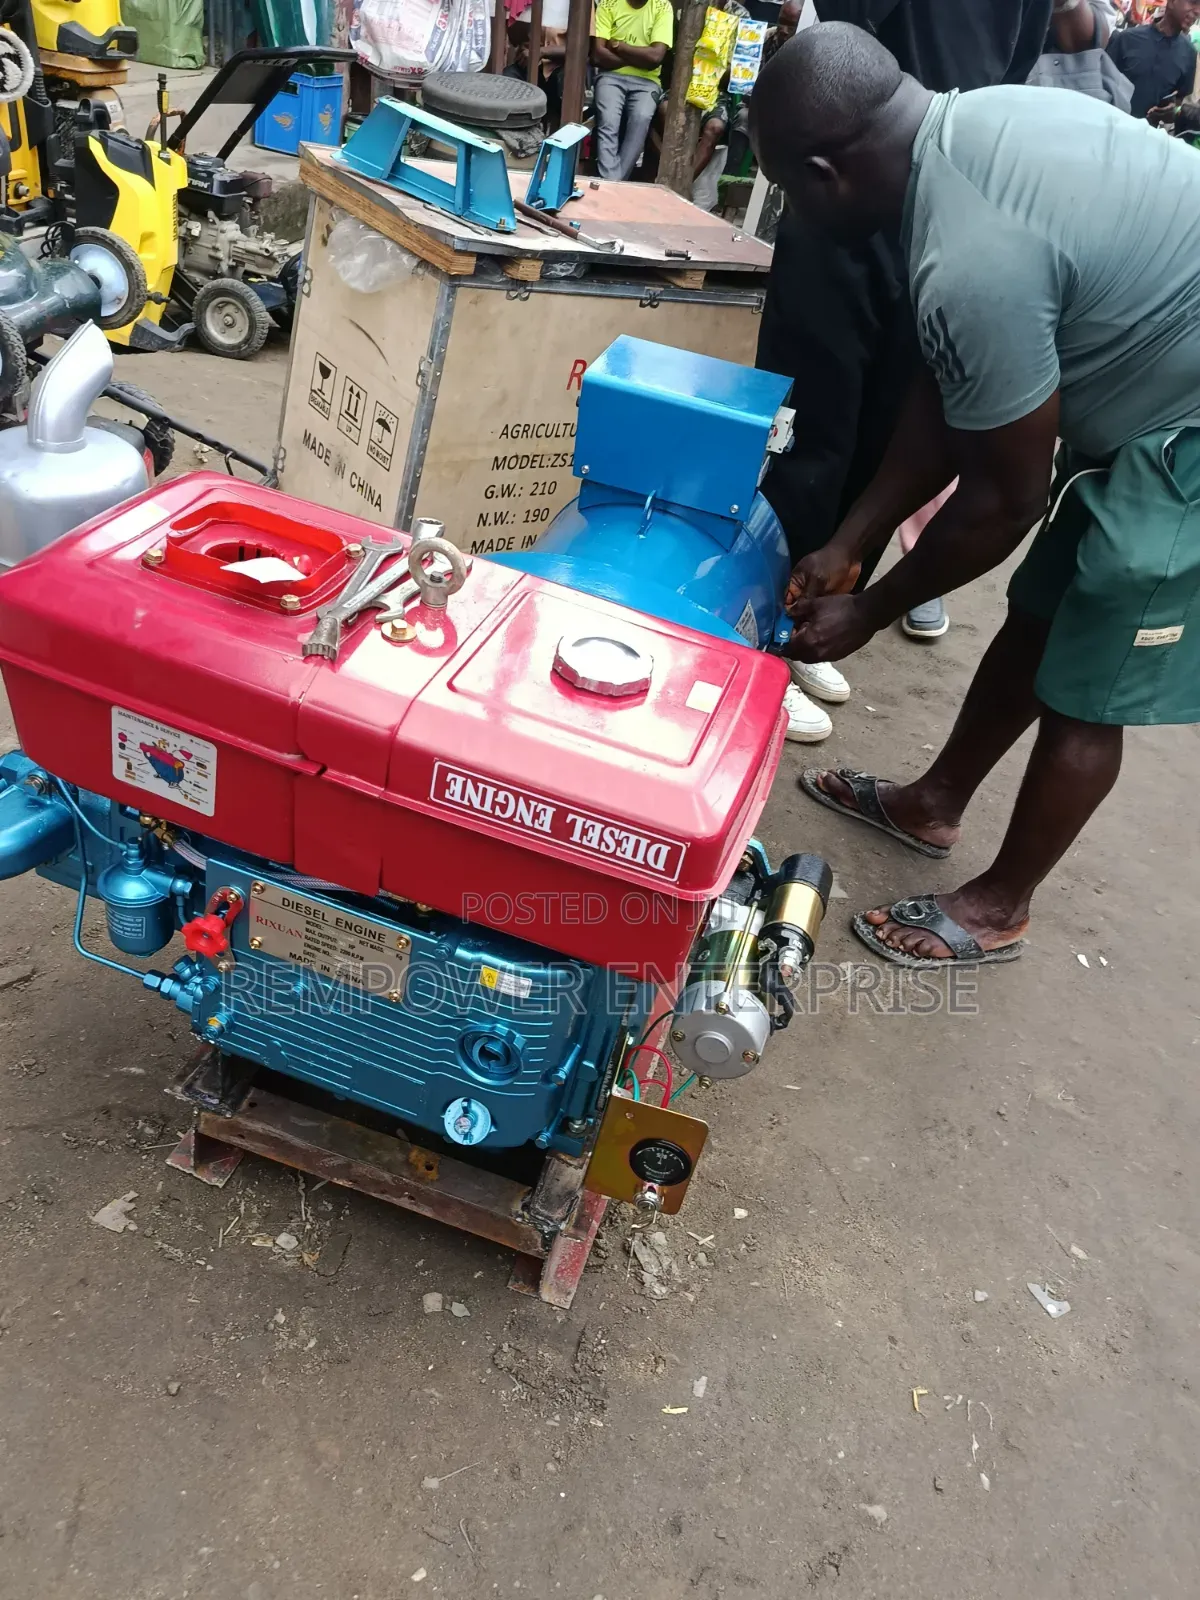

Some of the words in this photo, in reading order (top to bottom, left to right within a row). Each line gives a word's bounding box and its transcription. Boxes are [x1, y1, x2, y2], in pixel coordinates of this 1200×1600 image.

[345, 423, 352, 433] UP
[499, 422, 577, 440] AGRICULTU
[375, 448, 389, 465] MOIST
[491, 453, 575, 471] MODEL:ZS1
[302, 429, 331, 466] MADE
[335, 461, 346, 479] IN
[350, 471, 382, 512] CHINA
[484, 484, 523, 499] G.W.:
[529, 481, 557, 497] 210
[477, 510, 516, 527] N.W.:
[522, 507, 550, 523] 190
[470, 537, 515, 555] MADE
[521, 534, 537, 549] IN
[444, 772, 556, 833] ENGINE
[566, 813, 671, 872] DIESEL
[256, 915, 303, 939] RIXUAN
[282, 897, 329, 922] DIESEL
[335, 917, 386, 943] ENGINE
[288, 951, 317, 967] MADE
[320, 964, 330, 973] IN
[336, 967, 365, 986] CHINA
